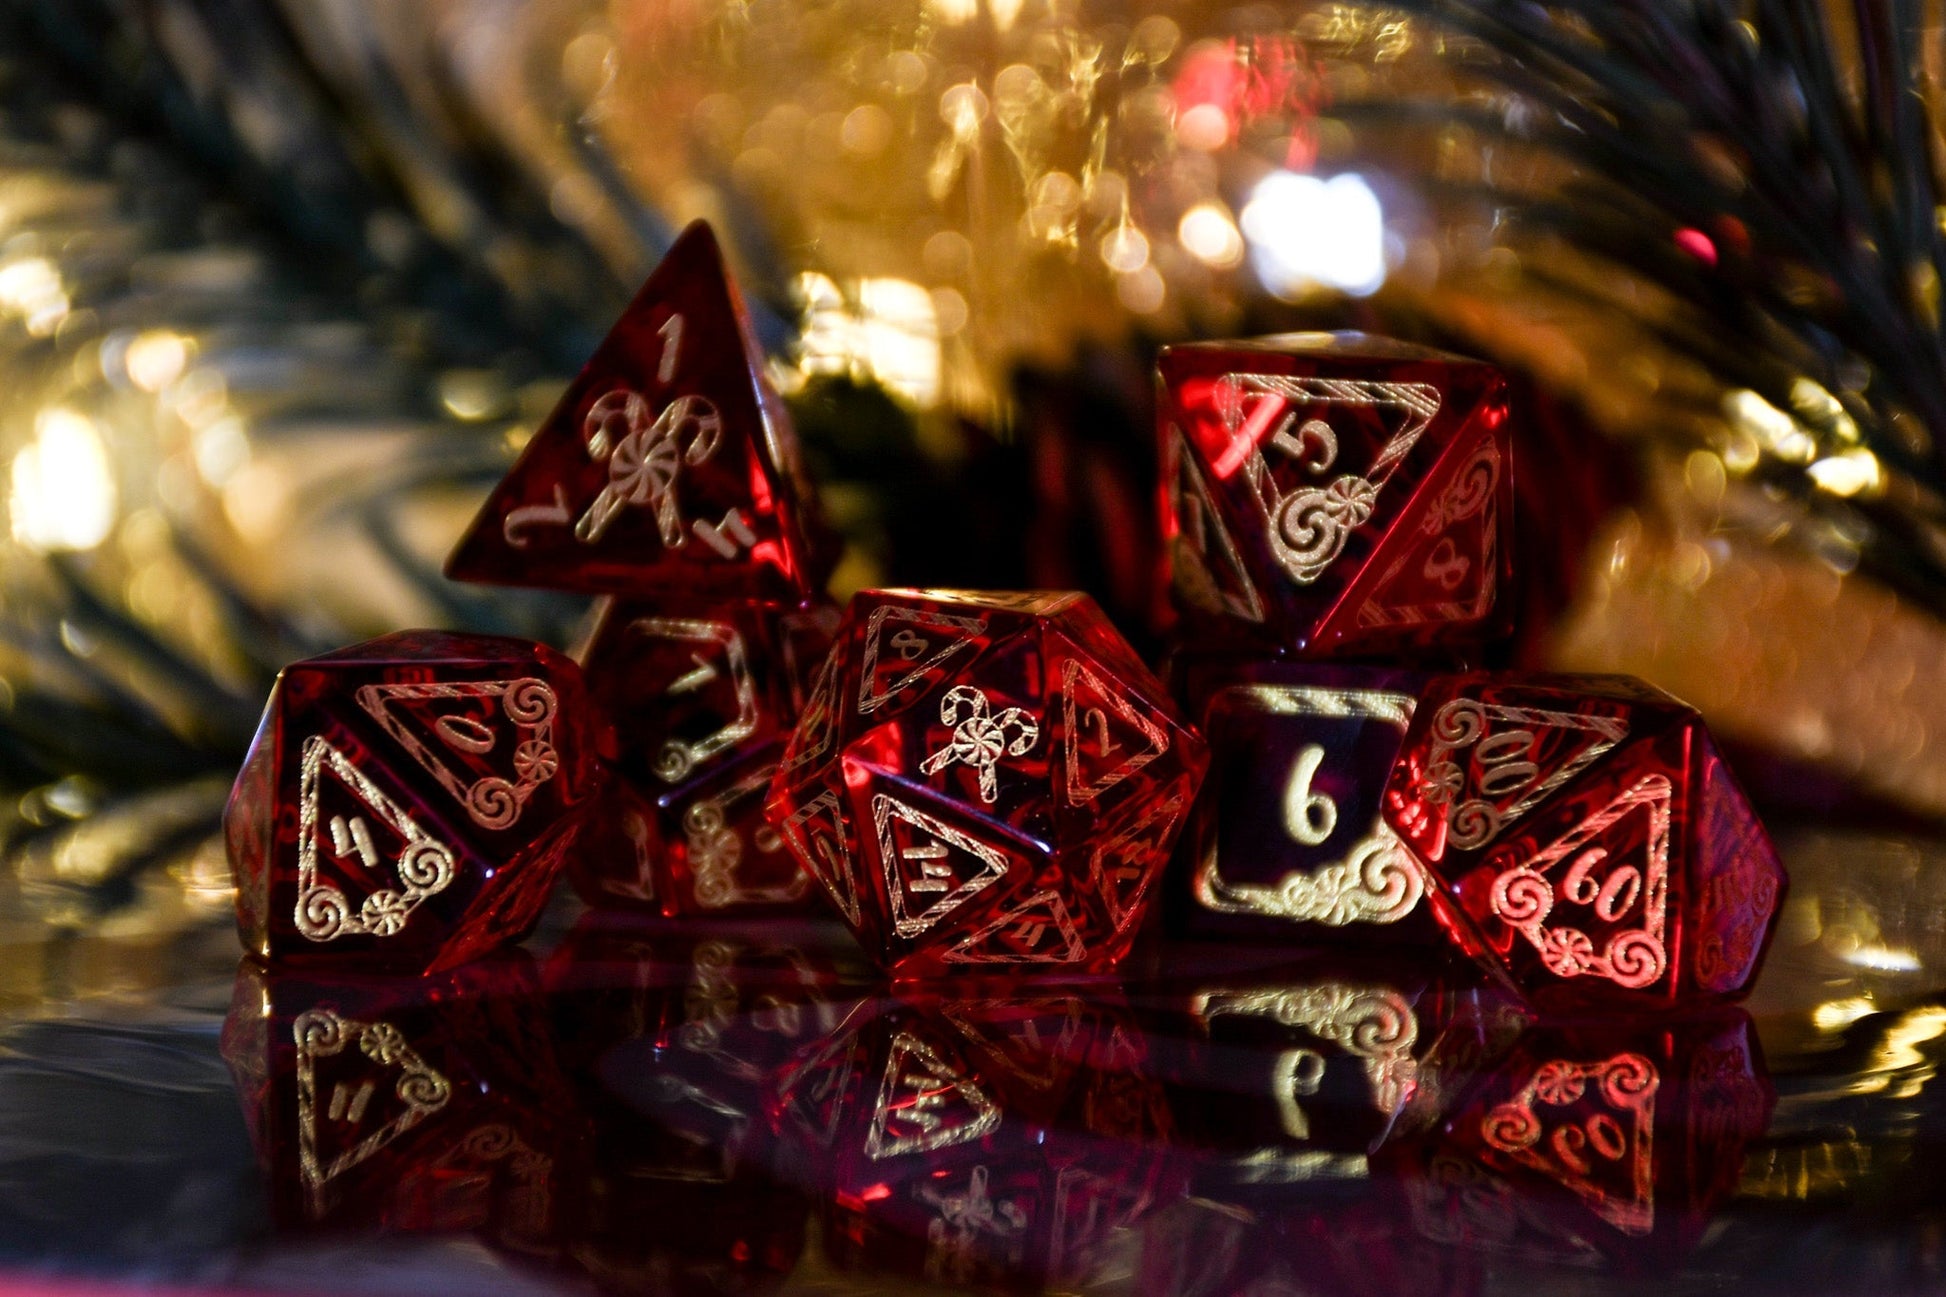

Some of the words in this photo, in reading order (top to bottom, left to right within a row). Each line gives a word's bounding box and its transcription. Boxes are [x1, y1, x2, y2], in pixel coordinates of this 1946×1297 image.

[657, 313, 686, 383] 1
[1269, 411, 1338, 475] 5
[504, 482, 573, 547] 2
[692, 507, 757, 559] 4
[1423, 537, 1471, 590] 8
[890, 629, 929, 660] 8
[435, 715, 496, 753] 0
[1084, 707, 1121, 758] 2
[1475, 730, 1540, 796] 00
[1283, 743, 1338, 846] 6
[329, 815, 380, 867] 4
[902, 841, 953, 892] 14
[1563, 846, 1642, 922] 60
